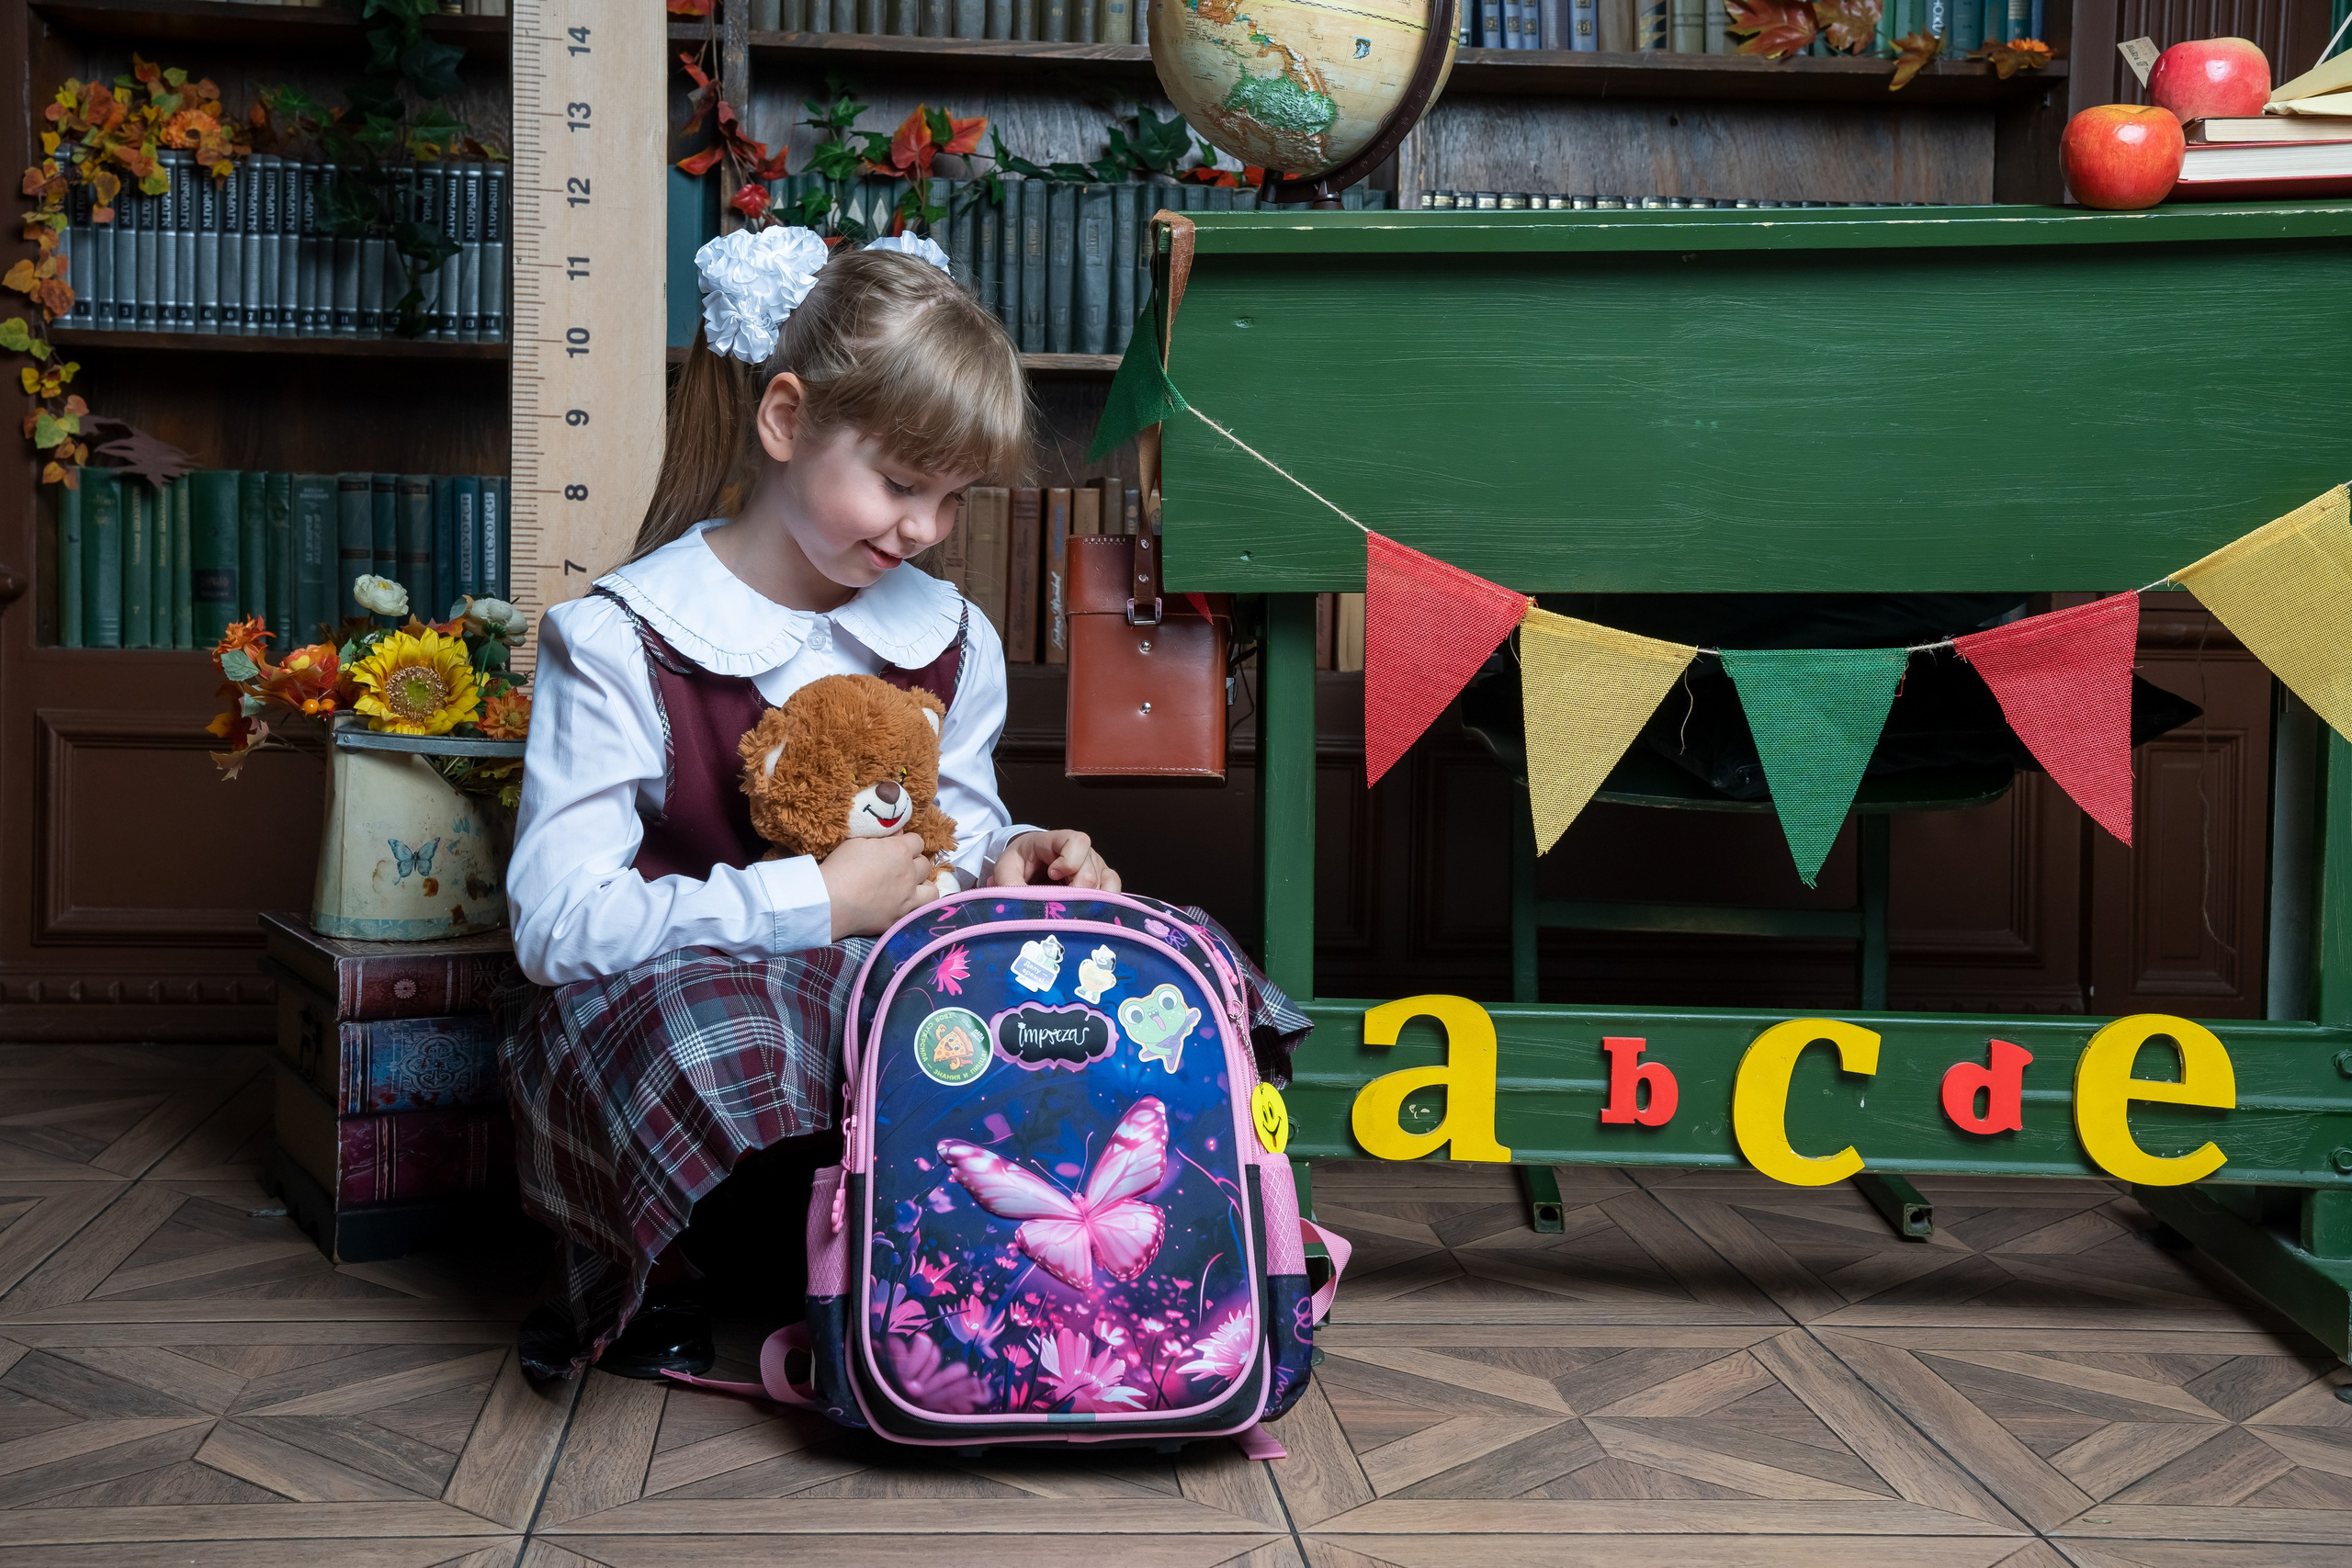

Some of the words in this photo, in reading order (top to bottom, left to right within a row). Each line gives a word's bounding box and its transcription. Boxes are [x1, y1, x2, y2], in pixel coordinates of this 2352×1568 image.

[568, 27, 591, 57] 14
[567, 102, 592, 132] 13
[567, 177, 591, 208] 12
[566, 256, 591, 281] 11
[248, 311, 254, 321] 7
[265, 311, 272, 321] 8
[285, 311, 292, 321] 8
[566, 327, 591, 358] 10
[565, 409, 590, 426] 9
[564, 484, 589, 502] 8
[461, 497, 470, 577] ГОЛСУОРСИ
[485, 496, 494, 575] ГОЛСУОРСИ
[564, 559, 587, 576] 7
[1022, 967, 1045, 984] время!
[1023, 960, 1041, 975] Делу
[920, 1022, 933, 1063] СУПЕРСИЛА
[933, 1068, 961, 1080] ЗНАНИЯ
[969, 1050, 988, 1074] ПИЦЦА!
[1351, 995, 1511, 1163] a
[1600, 1036, 1679, 1127] b
[1733, 1017, 1883, 1187] c
[1940, 1038, 2033, 1135] d
[2073, 1013, 2237, 1187] e
